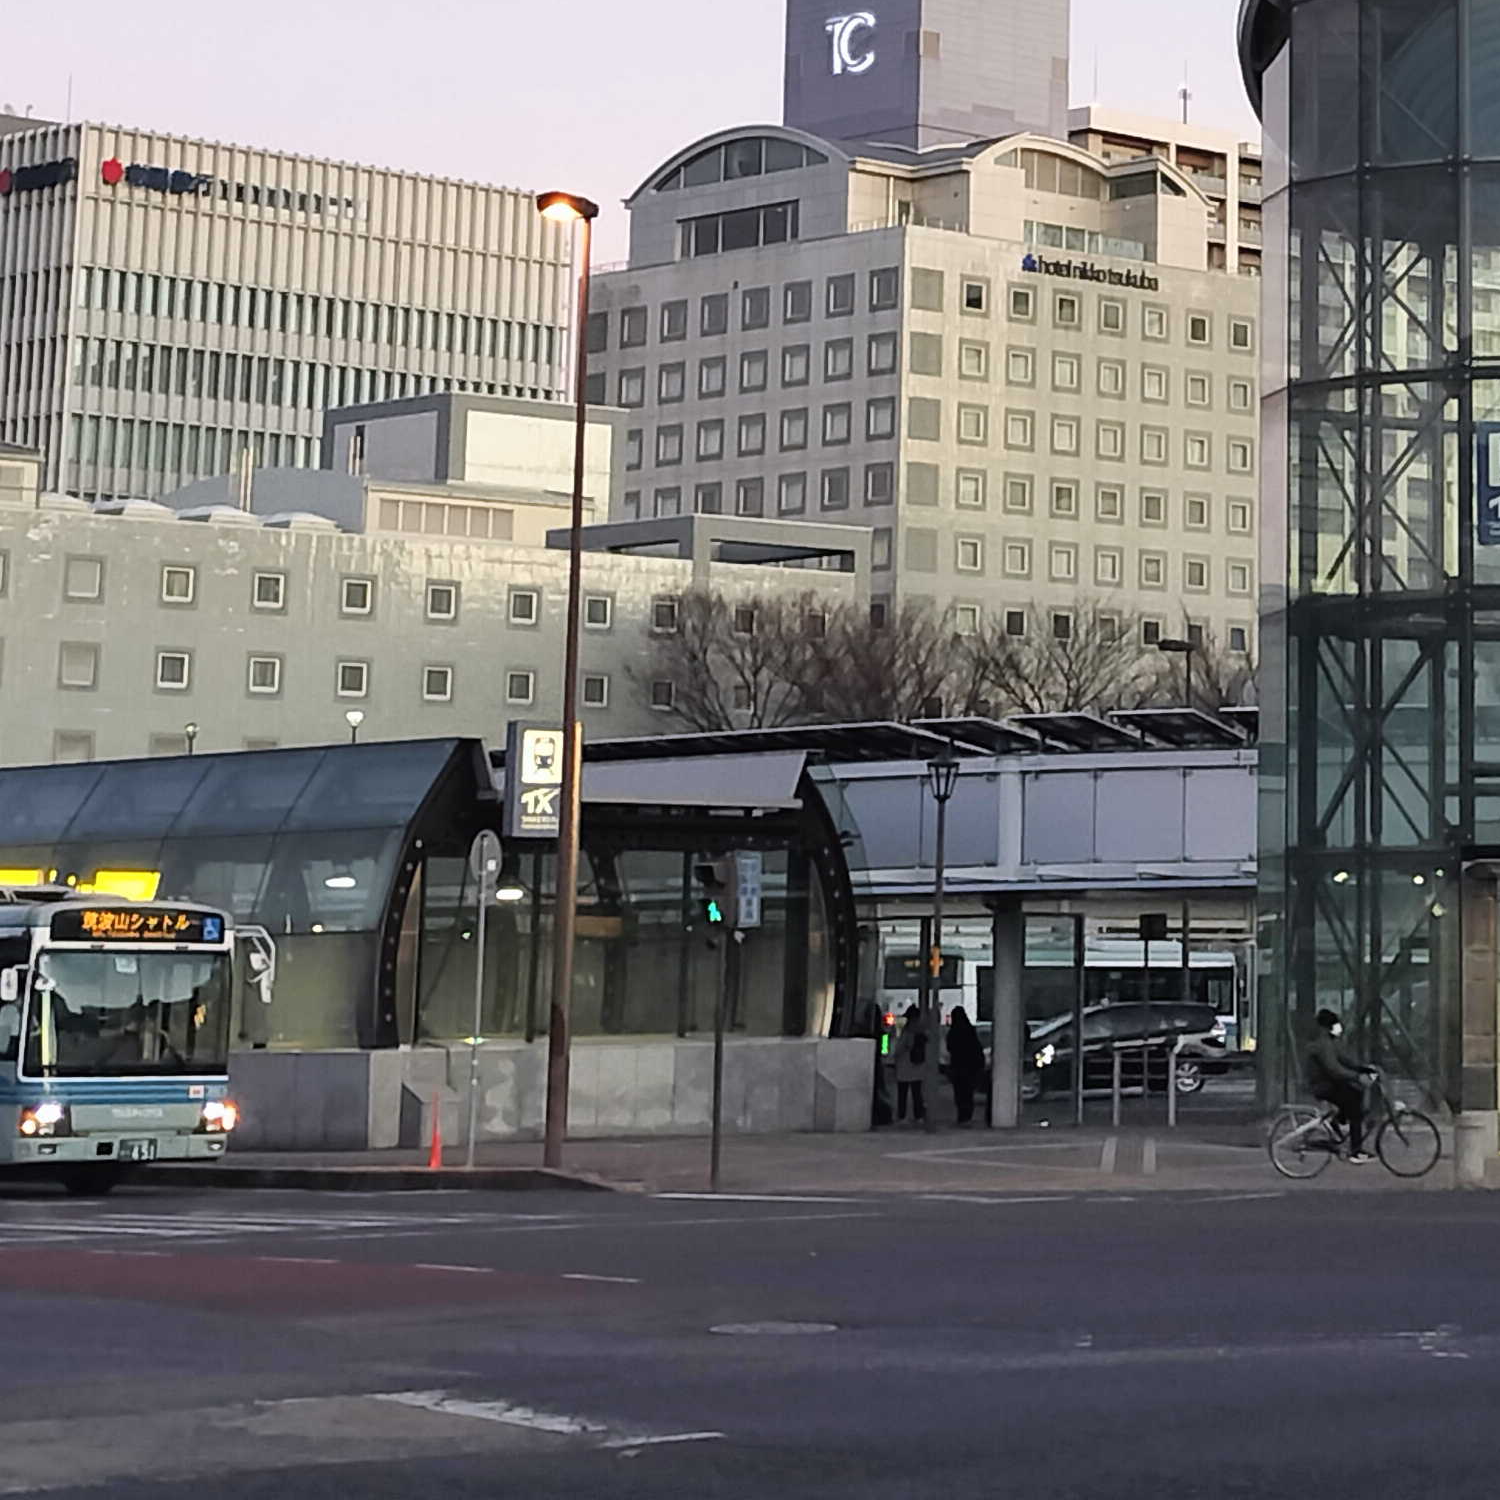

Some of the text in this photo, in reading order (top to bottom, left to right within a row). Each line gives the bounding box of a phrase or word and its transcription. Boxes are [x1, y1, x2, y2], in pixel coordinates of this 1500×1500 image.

[1038, 255, 1159, 291] hotel nikko tsukuba
[520, 787, 561, 814] TX
